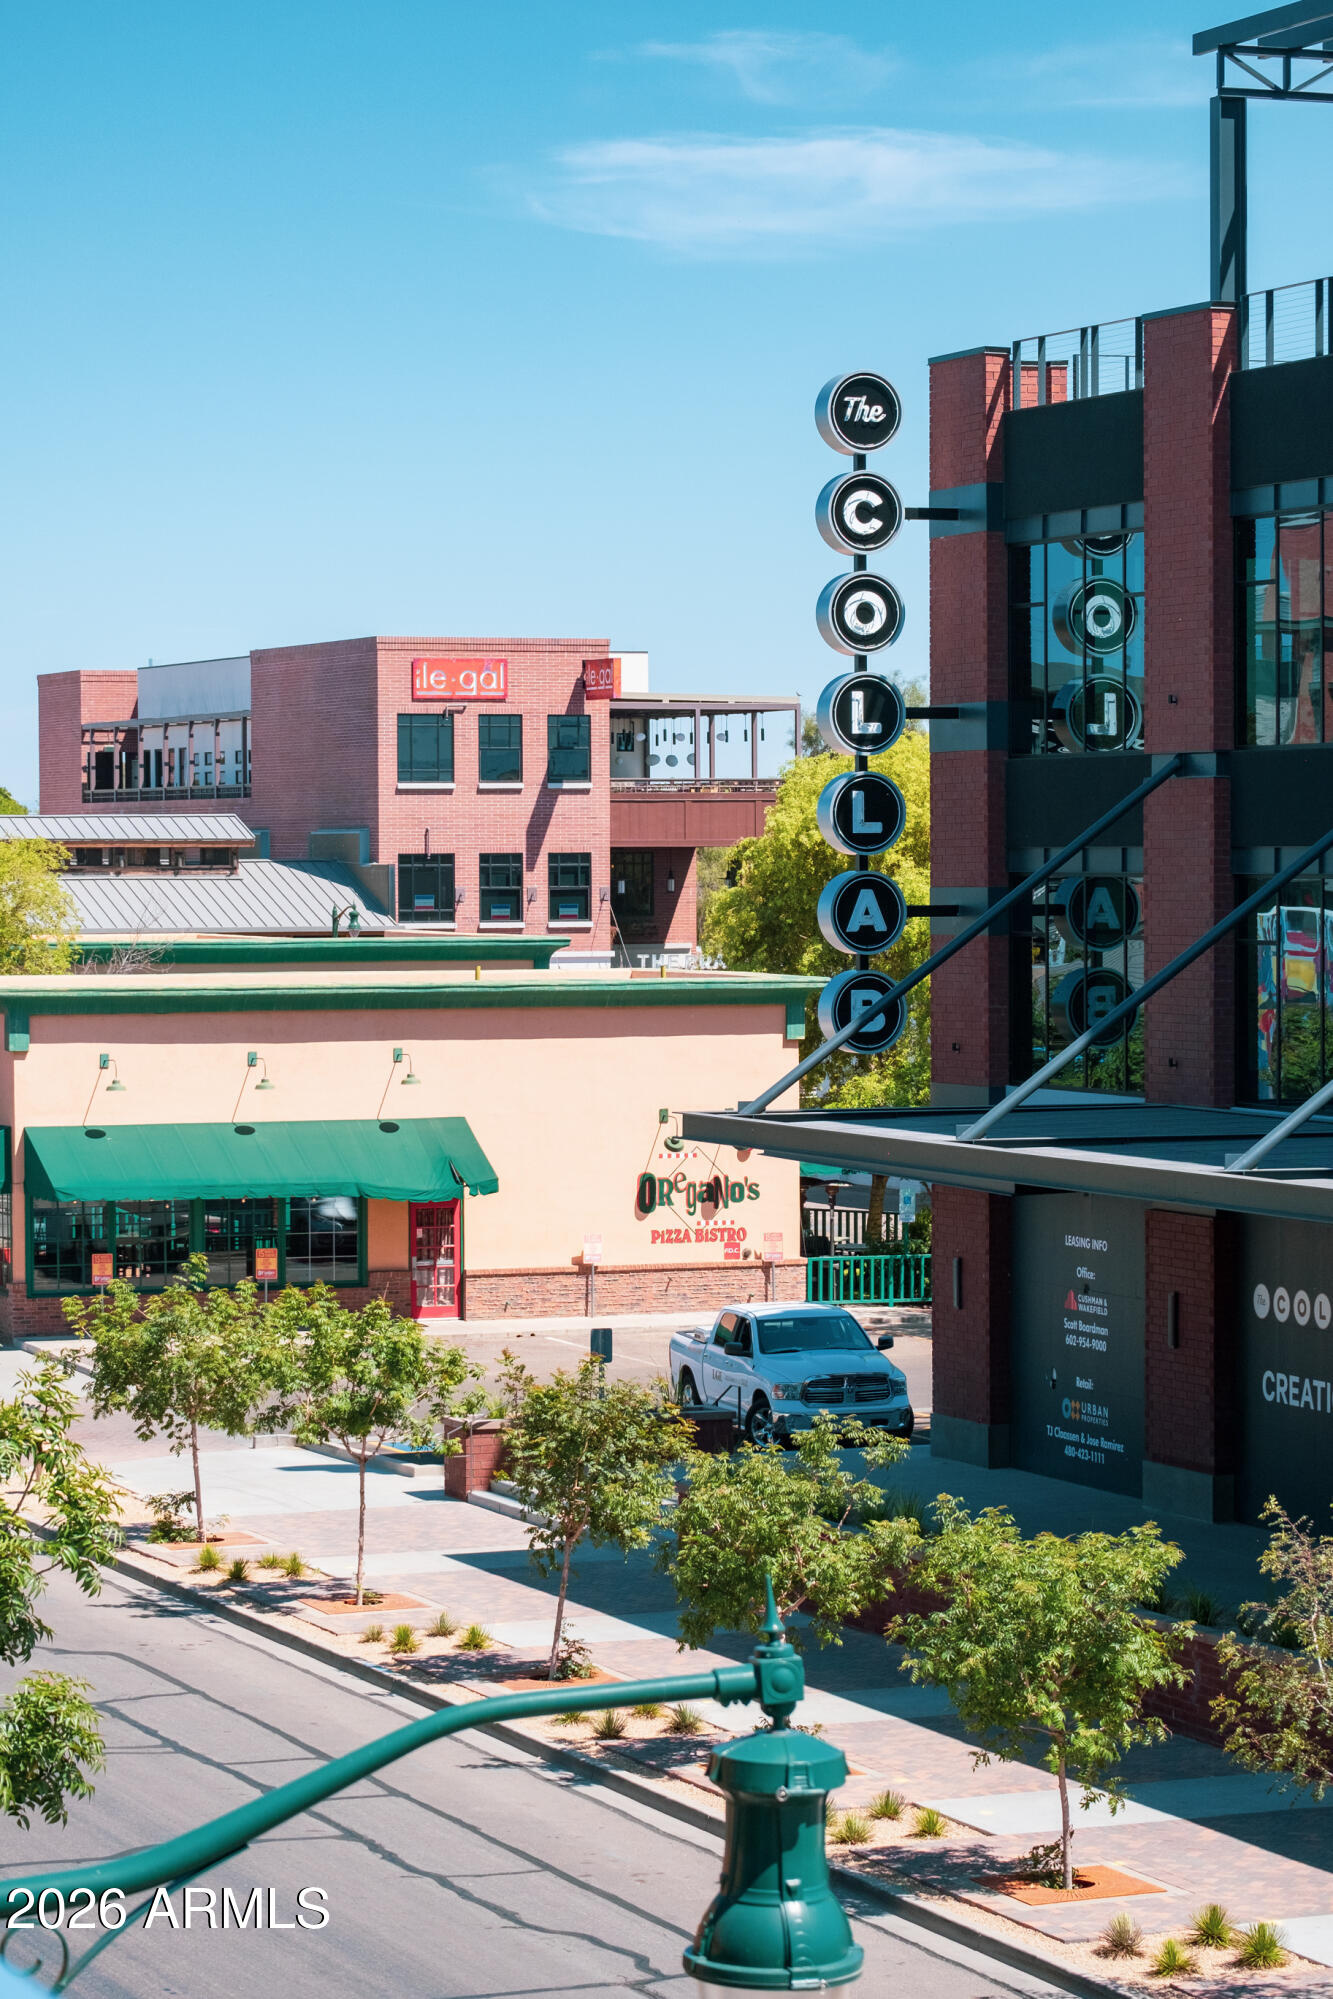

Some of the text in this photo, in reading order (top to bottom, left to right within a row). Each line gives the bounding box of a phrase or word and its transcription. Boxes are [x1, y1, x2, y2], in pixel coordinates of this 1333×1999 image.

[843, 395, 888, 1033] The COLLAB
[636, 1171, 761, 1216] ORegaNo's
[650, 1227, 747, 1244] PiZZA BiSTRO
[1065, 1235, 1108, 1252] LEASING INFO
[1077, 1267, 1096, 1280] Office:
[1078, 1295, 1103, 1306] CUSHMAN
[1256, 1294, 1266, 1306] The
[1079, 1304, 1108, 1316] WAKEFIELD
[1064, 1318, 1109, 1336] Scott Boardman
[1066, 1335, 1107, 1352] 602-954-9000
[1076, 1377, 1094, 1390] Retail:
[1262, 1370, 1333, 1414] CREATI
[1081, 1402, 1109, 1418] URBAN
[1082, 1415, 1109, 1427] PROPERTIES
[1046, 1425, 1054, 1437] TJ
[1080, 1433, 1086, 1444] &
[1087, 1434, 1100, 1447] Jose
[1101, 1438, 1124, 1453] Ramirez
[1065, 1445, 1105, 1464] 480-423-1111
